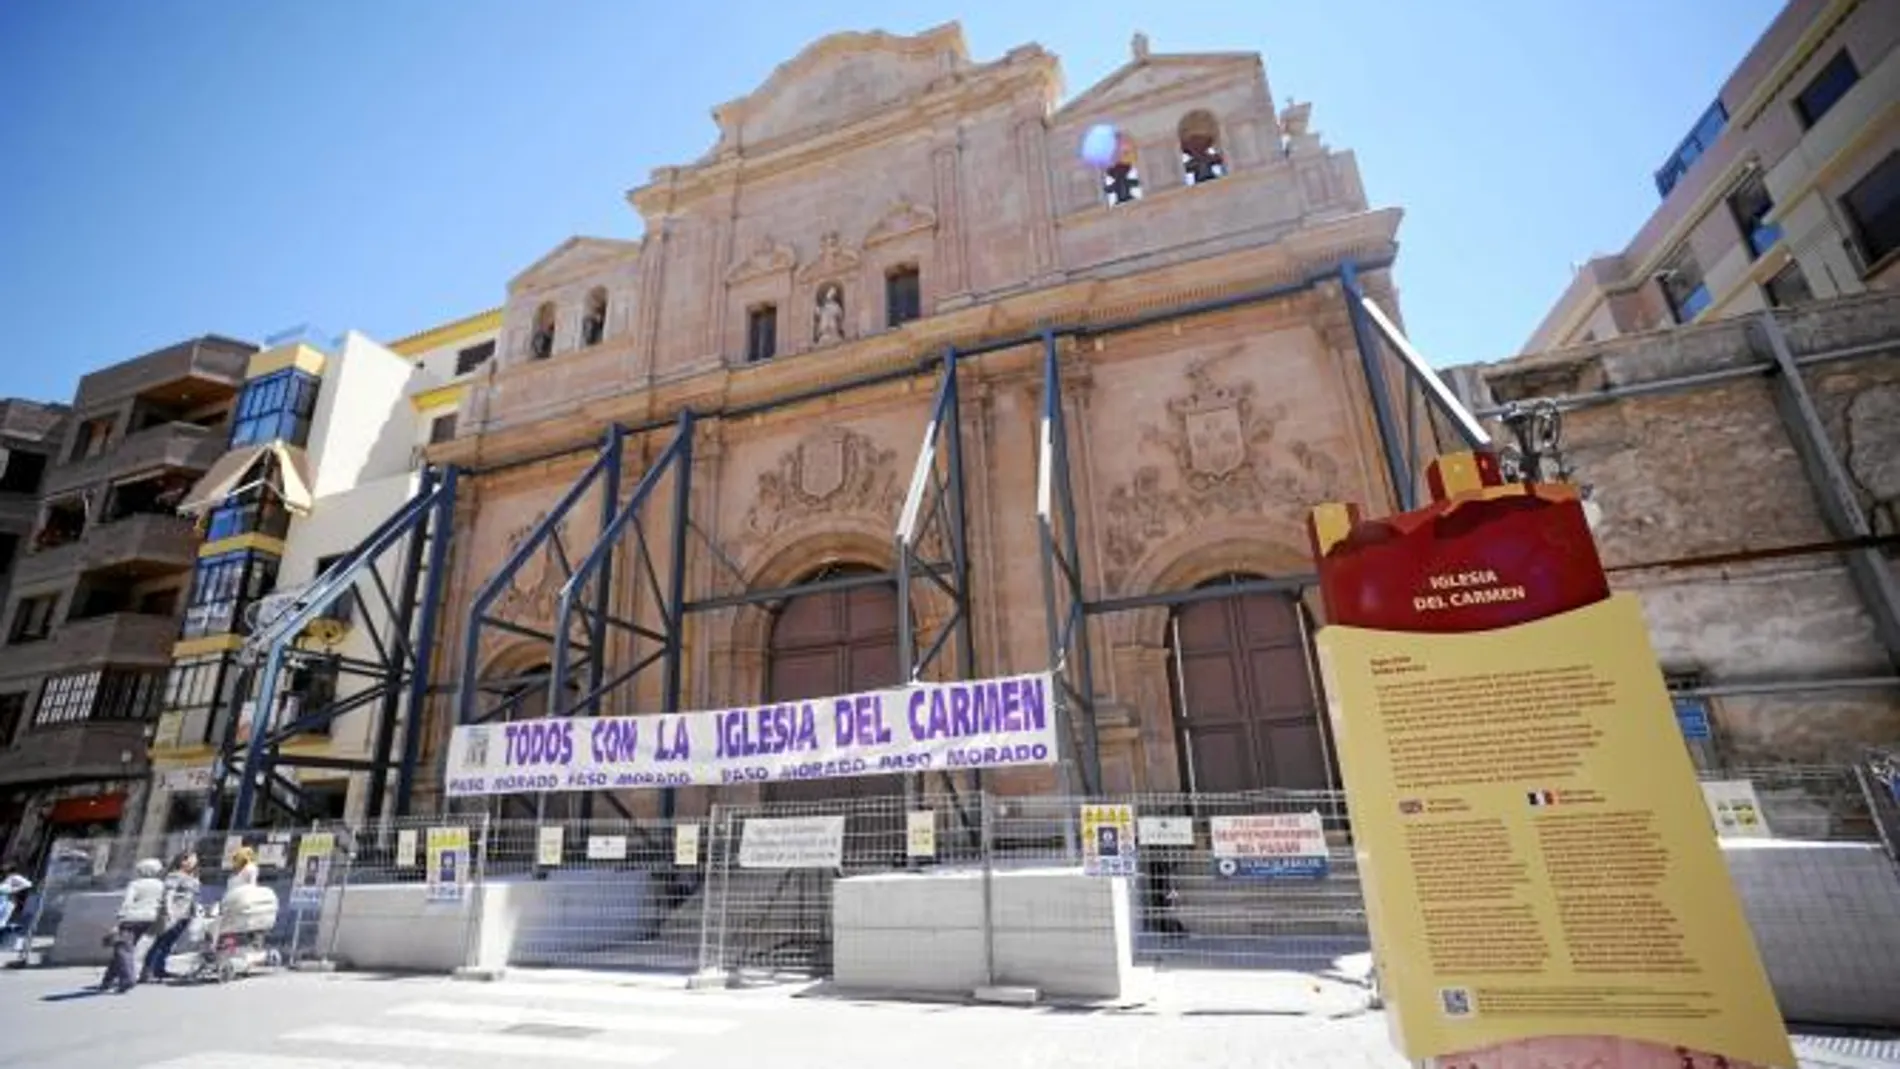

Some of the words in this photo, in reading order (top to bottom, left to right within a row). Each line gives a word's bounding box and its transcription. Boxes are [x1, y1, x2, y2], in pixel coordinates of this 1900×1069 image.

[1428, 570, 1498, 589] IGLESIA
[1413, 595, 1449, 612] DEL
[1450, 585, 1525, 606] CARMEN
[505, 722, 573, 765] TODOS
[591, 720, 638, 763] CON
[655, 716, 690, 761] LA
[715, 703, 818, 758] IGLESIA
[834, 695, 891, 748] DEL
[907, 677, 1046, 741] CARMEN
[492, 775, 559, 789] MORADO
[615, 770, 692, 786] MORADO
[721, 766, 769, 783] PASO
[778, 760, 867, 780] MORADO
[878, 751, 933, 770] PASO
[946, 743, 1048, 766] MORADO
